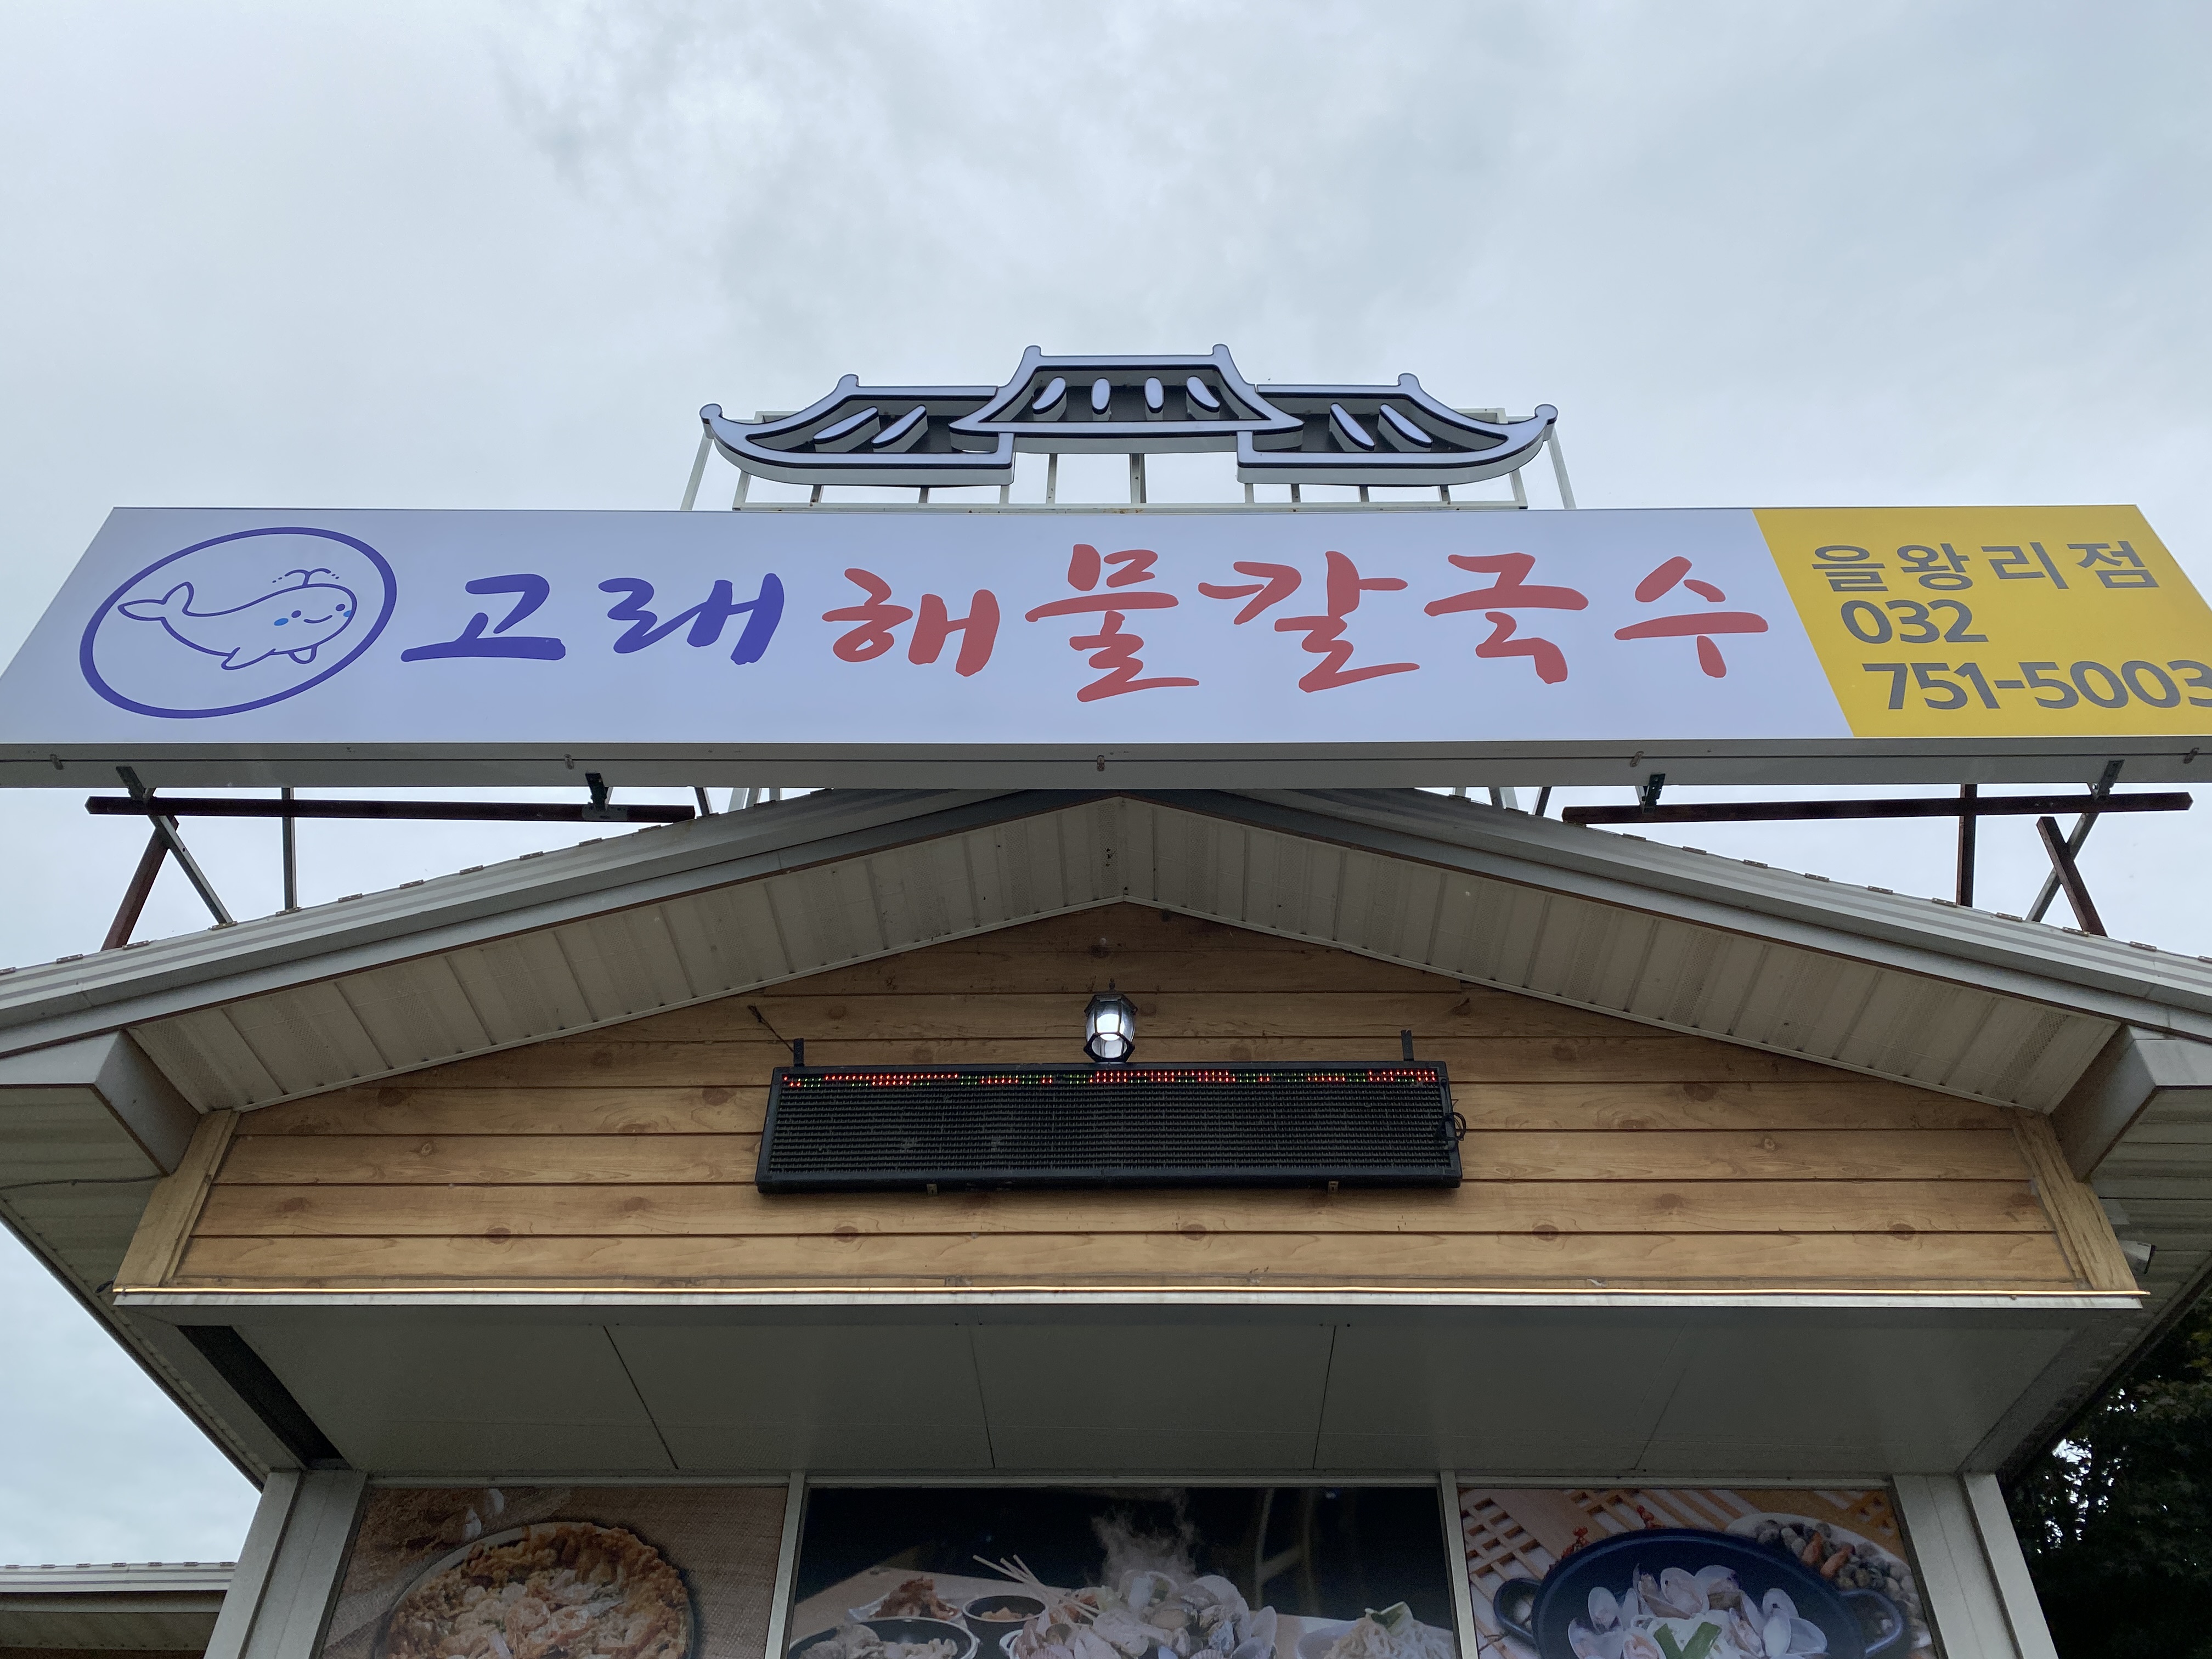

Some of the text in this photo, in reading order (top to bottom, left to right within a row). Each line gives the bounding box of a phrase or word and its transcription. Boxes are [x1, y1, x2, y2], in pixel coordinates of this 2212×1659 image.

[1811, 540, 2160, 592] 을왕리점
[400, 541, 1769, 702] 고래 해물칼국수
[1840, 599, 1989, 645] 032
[1861, 659, 2212, 710] 751-5003
